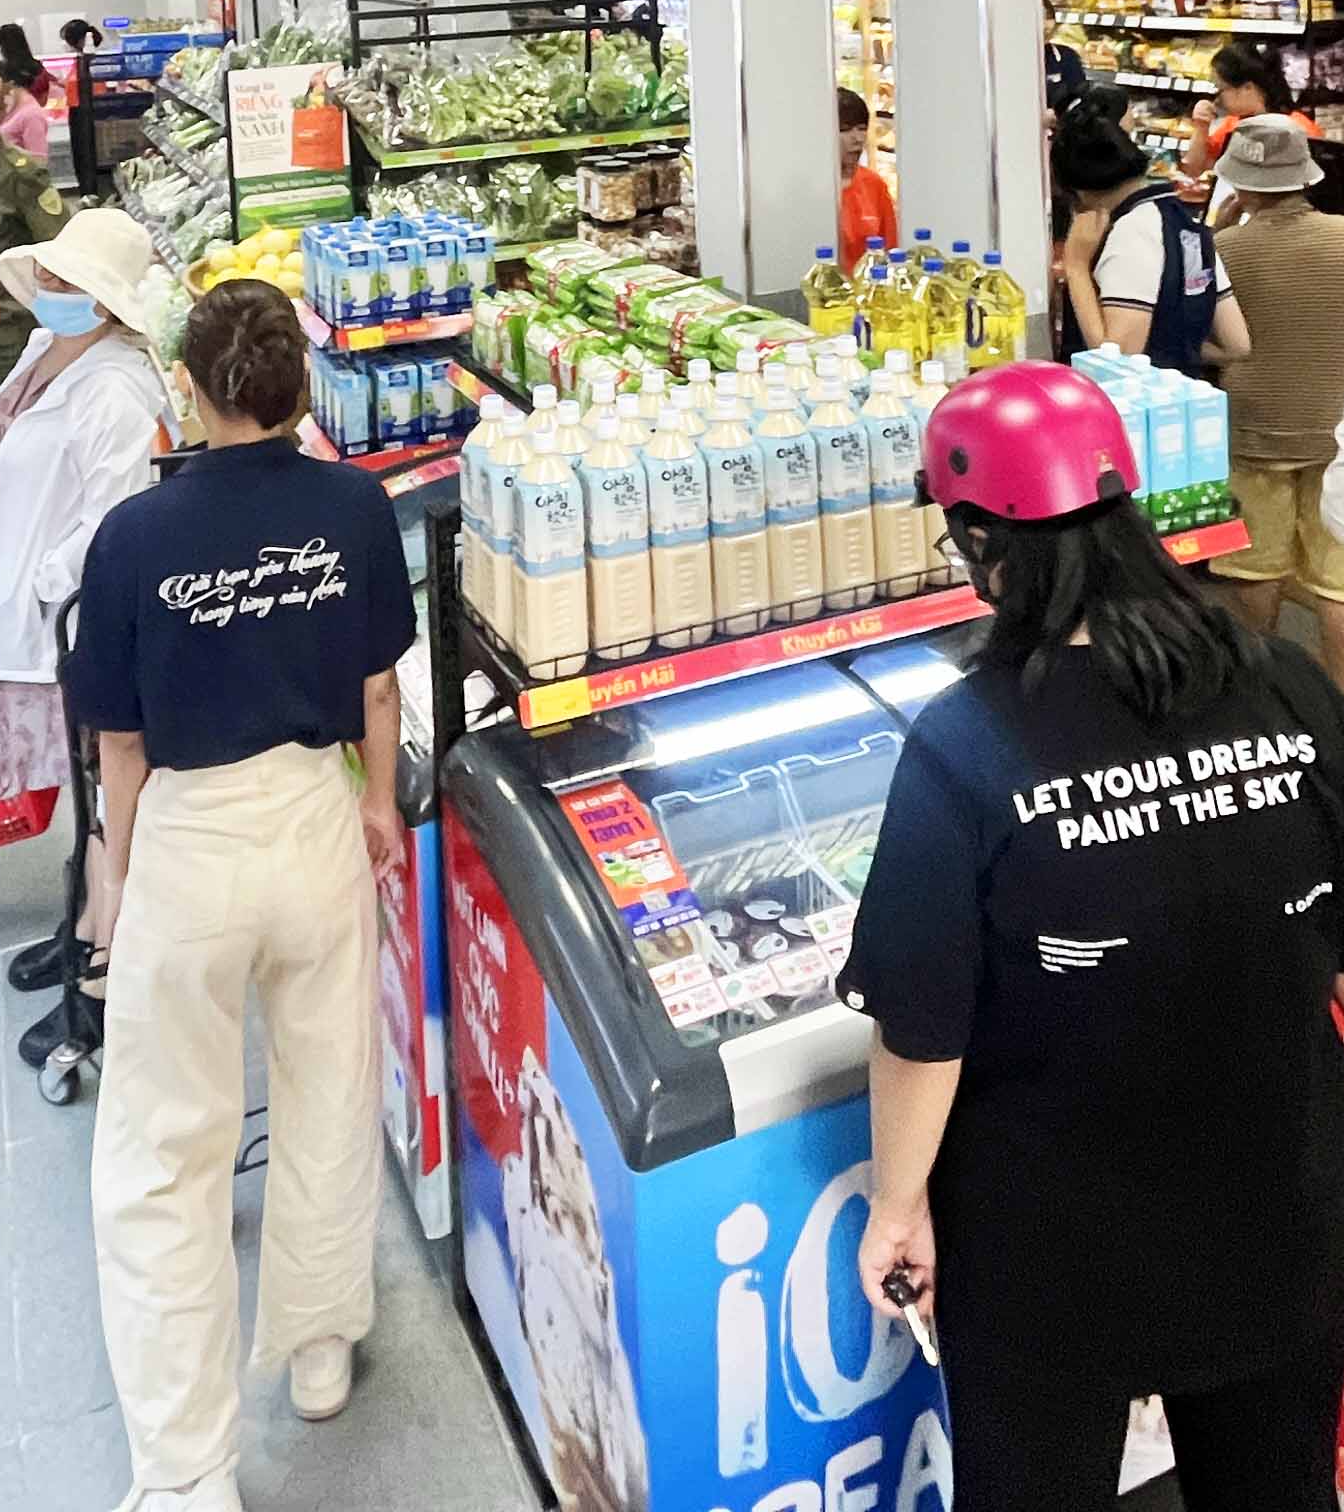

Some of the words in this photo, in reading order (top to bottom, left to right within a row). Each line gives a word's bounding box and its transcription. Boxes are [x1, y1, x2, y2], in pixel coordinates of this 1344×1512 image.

[781, 624, 849, 656] Khuyến
[851, 614, 883, 638] Mãi
[588, 676, 637, 705] uyến
[640, 663, 675, 689] Mãi
[1012, 777, 1074, 824] LET
[1081, 756, 1183, 803] YOUR
[1187, 734, 1316, 782] DREAMS
[1057, 802, 1162, 850] PAINT
[1169, 785, 1239, 826] THE
[1243, 770, 1304, 811] SKY
